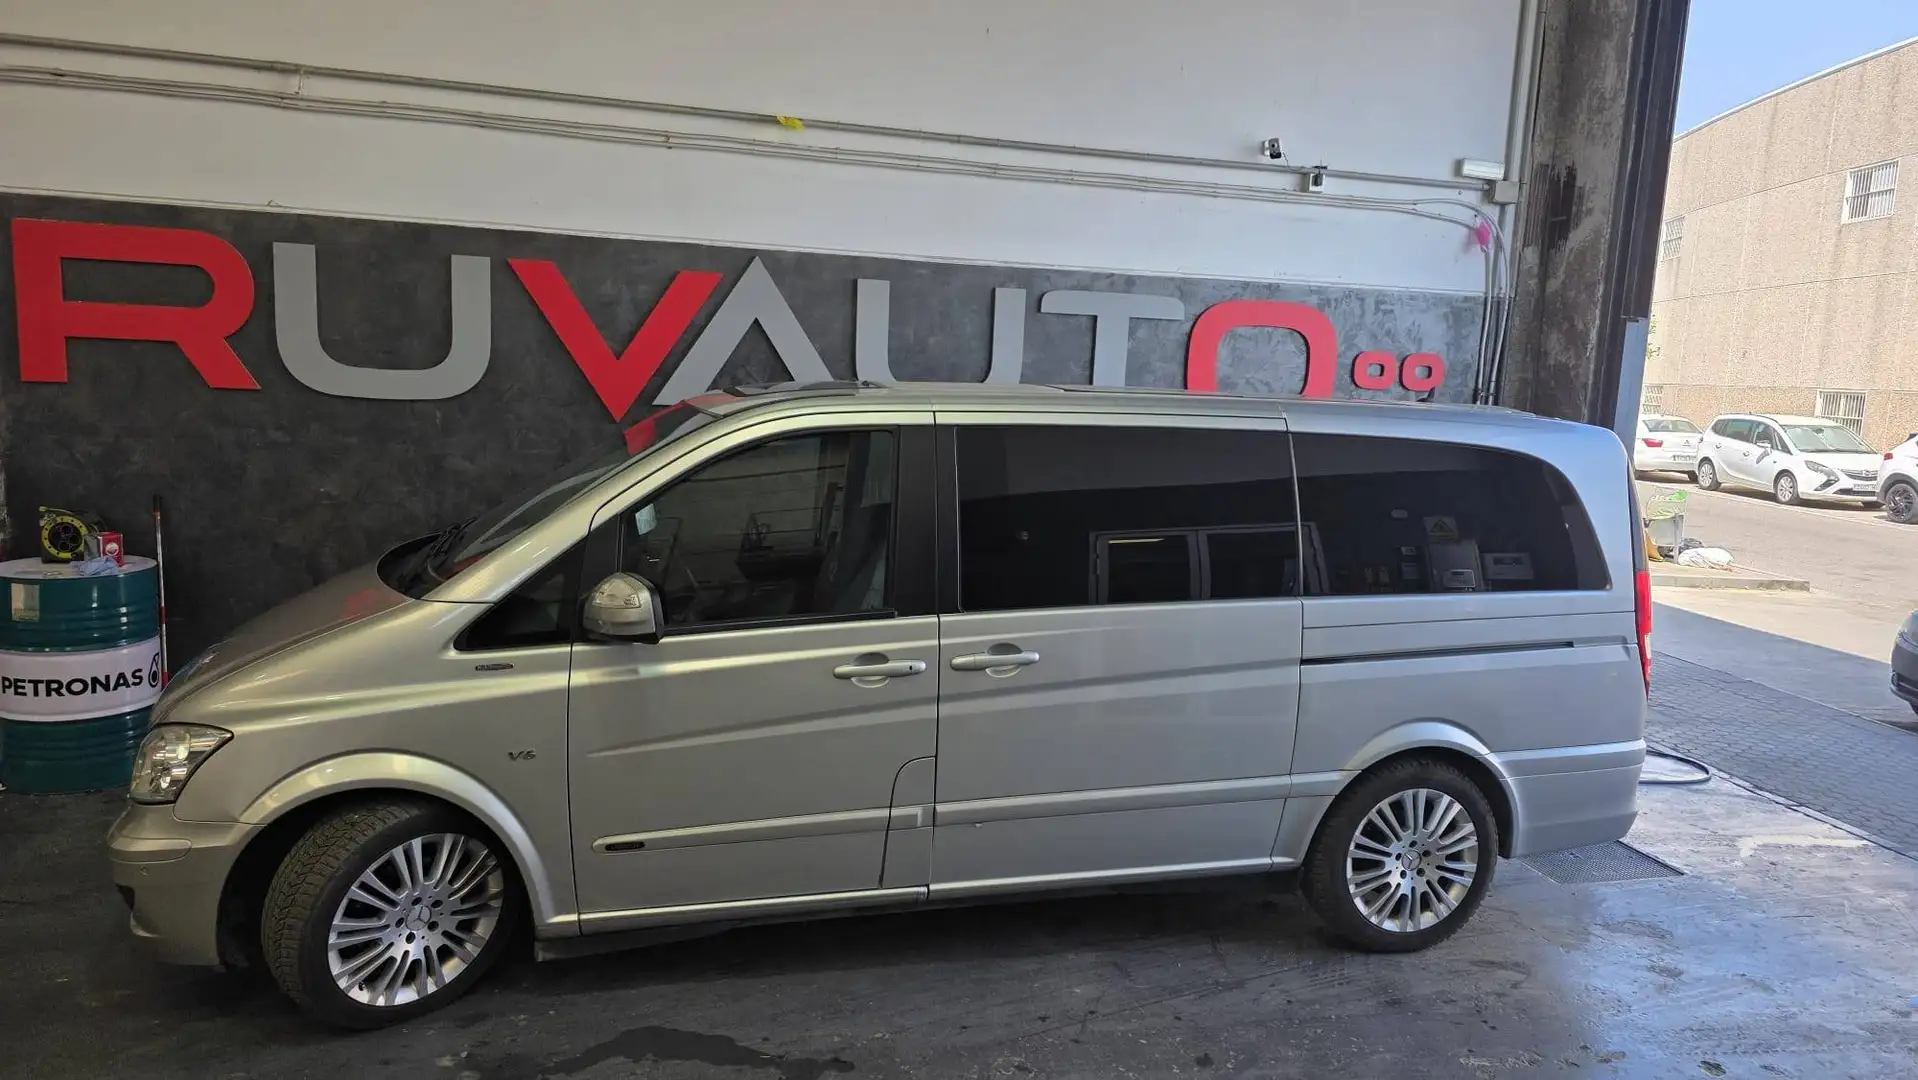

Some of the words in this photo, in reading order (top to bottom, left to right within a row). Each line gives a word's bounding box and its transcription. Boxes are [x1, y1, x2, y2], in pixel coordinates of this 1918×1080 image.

[12, 217, 1338, 422] RUVAUTO
[1, 668, 144, 697] PETRONAS
[508, 749, 537, 761] V6
